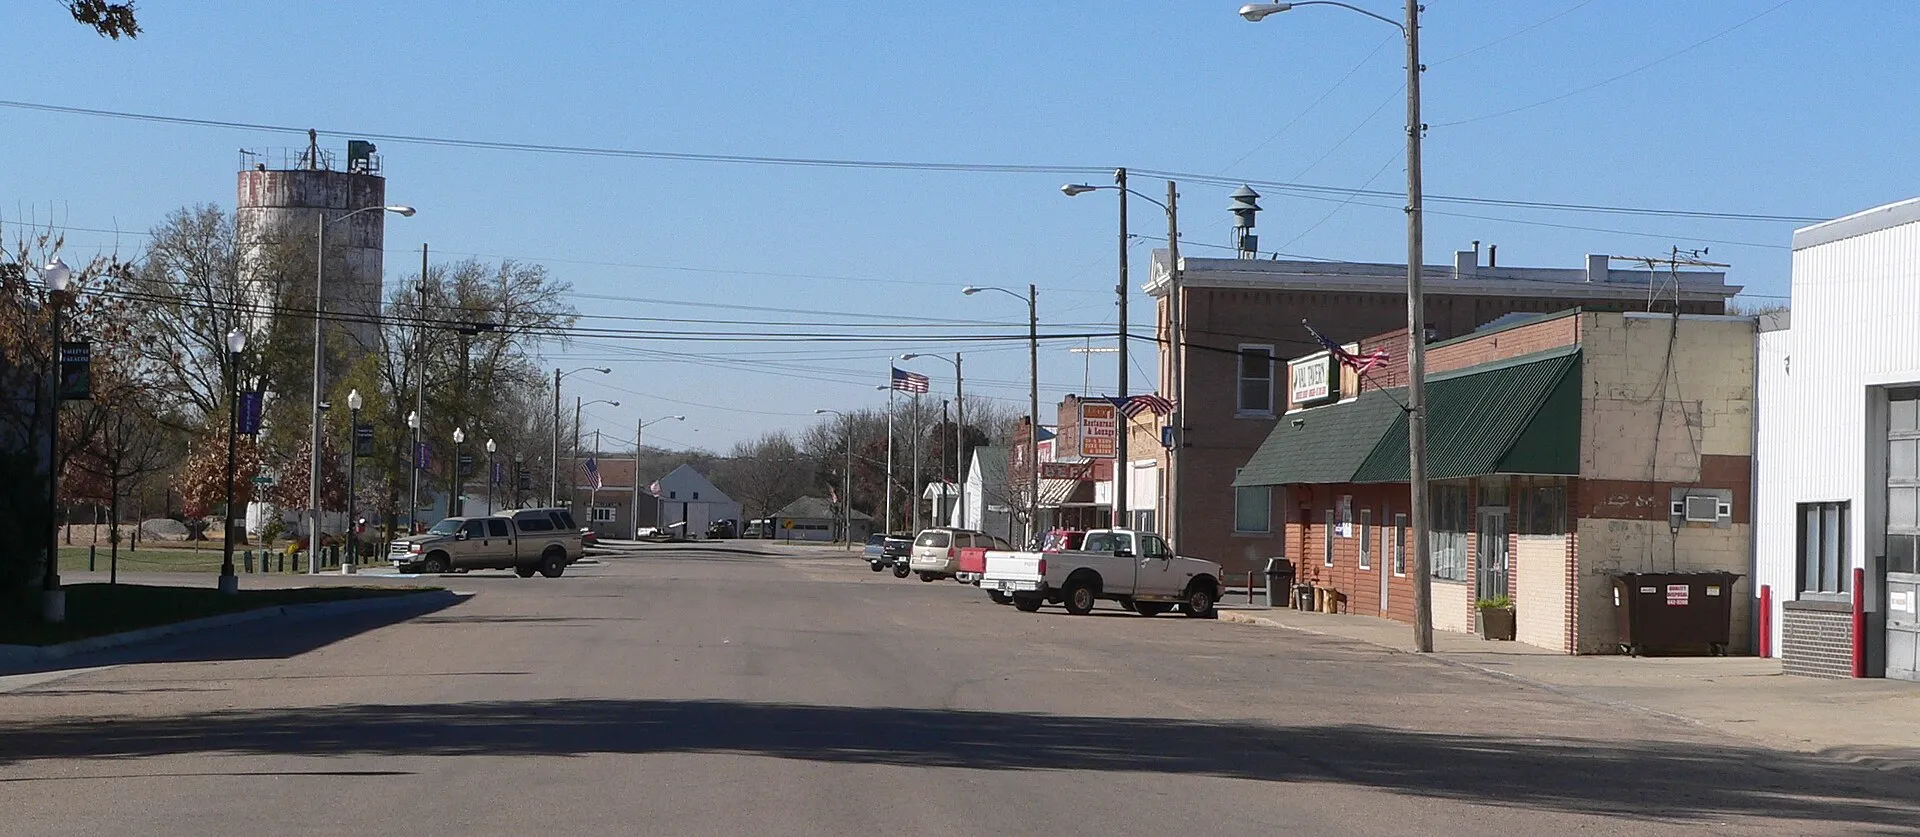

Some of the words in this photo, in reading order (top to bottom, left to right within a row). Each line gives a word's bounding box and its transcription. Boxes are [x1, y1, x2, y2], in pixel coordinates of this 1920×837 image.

[1308, 363, 1325, 386] TAVERN
[1083, 419, 1114, 427] Restaurant
[1095, 428, 1114, 437] Lounge
